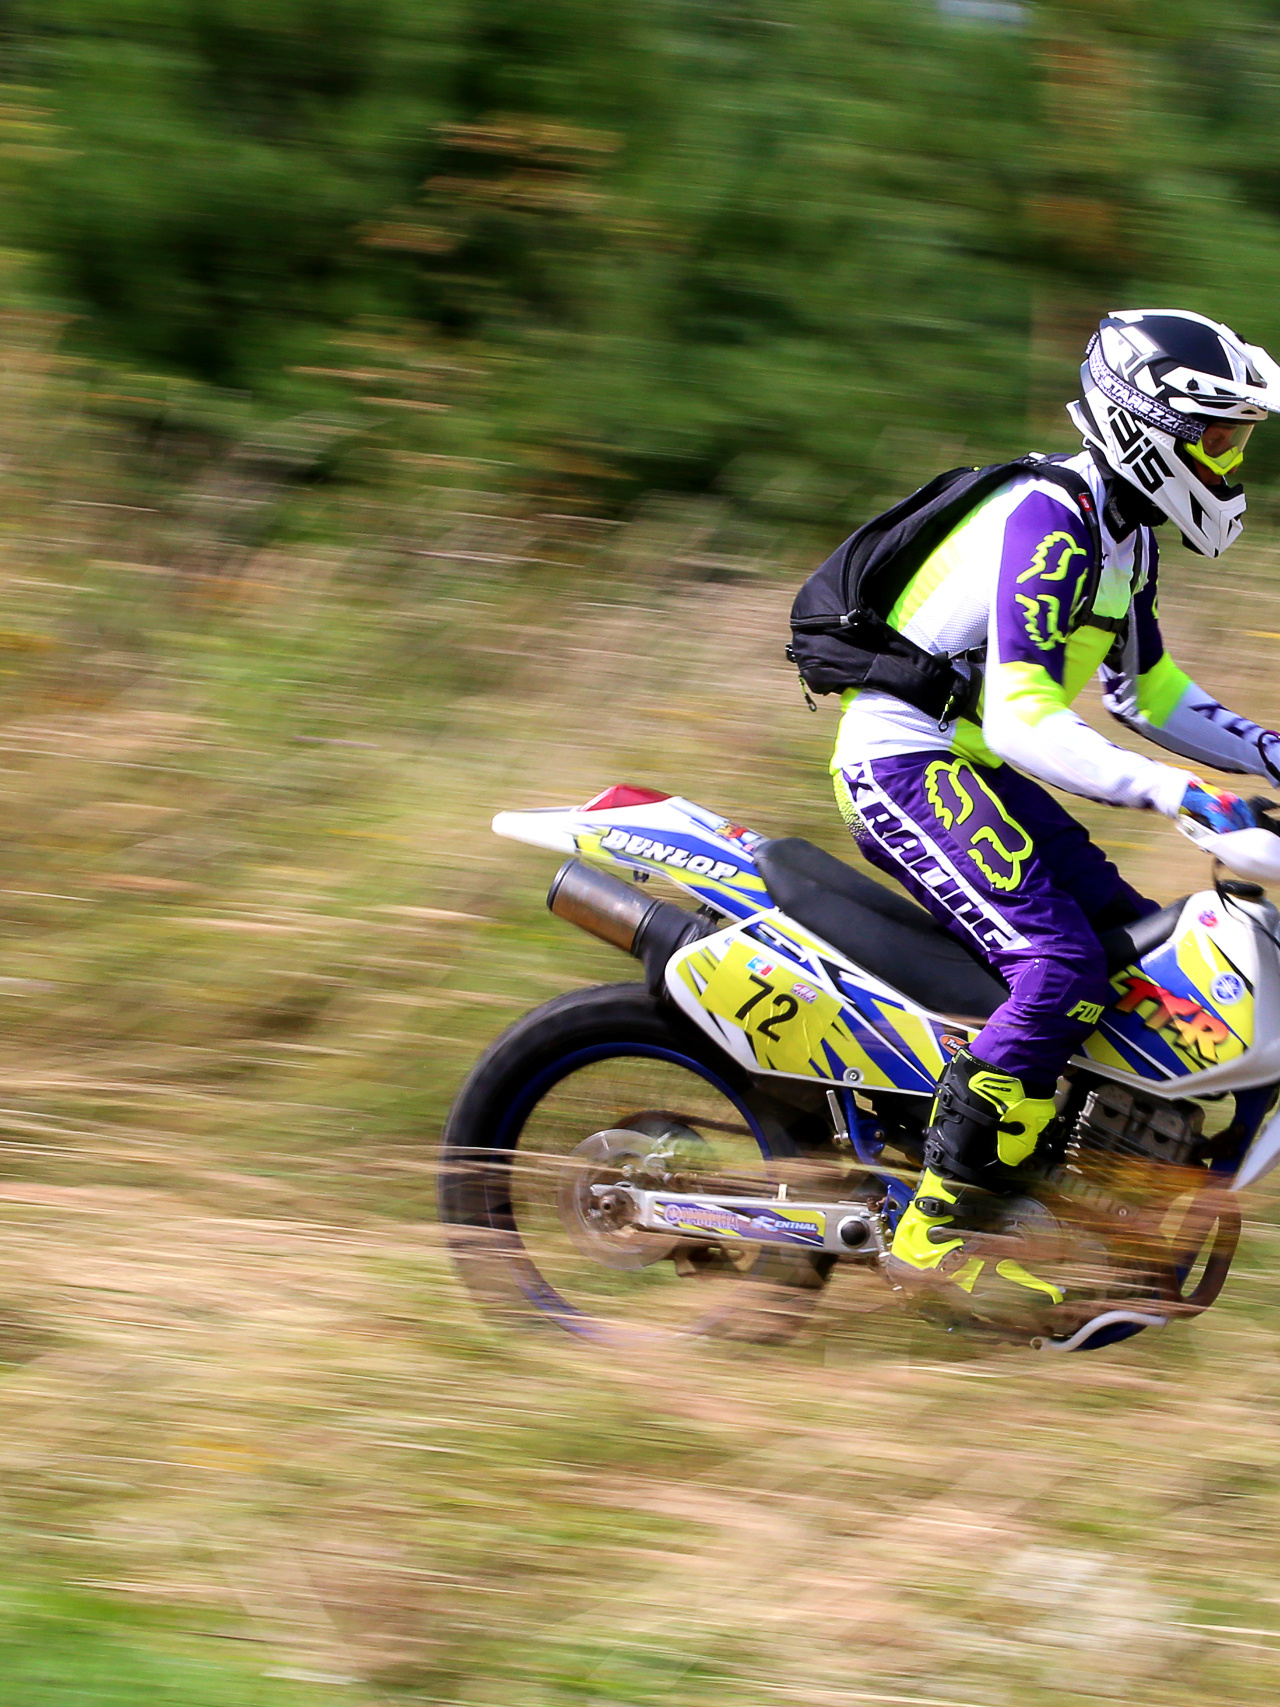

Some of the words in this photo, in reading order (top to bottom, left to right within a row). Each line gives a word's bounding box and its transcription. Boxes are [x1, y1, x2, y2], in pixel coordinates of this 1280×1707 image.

[600, 828, 738, 880] DUNLOP
[860, 801, 1013, 949] RACING
[735, 974, 799, 1042] 72
[1066, 999, 1105, 1025] FOX
